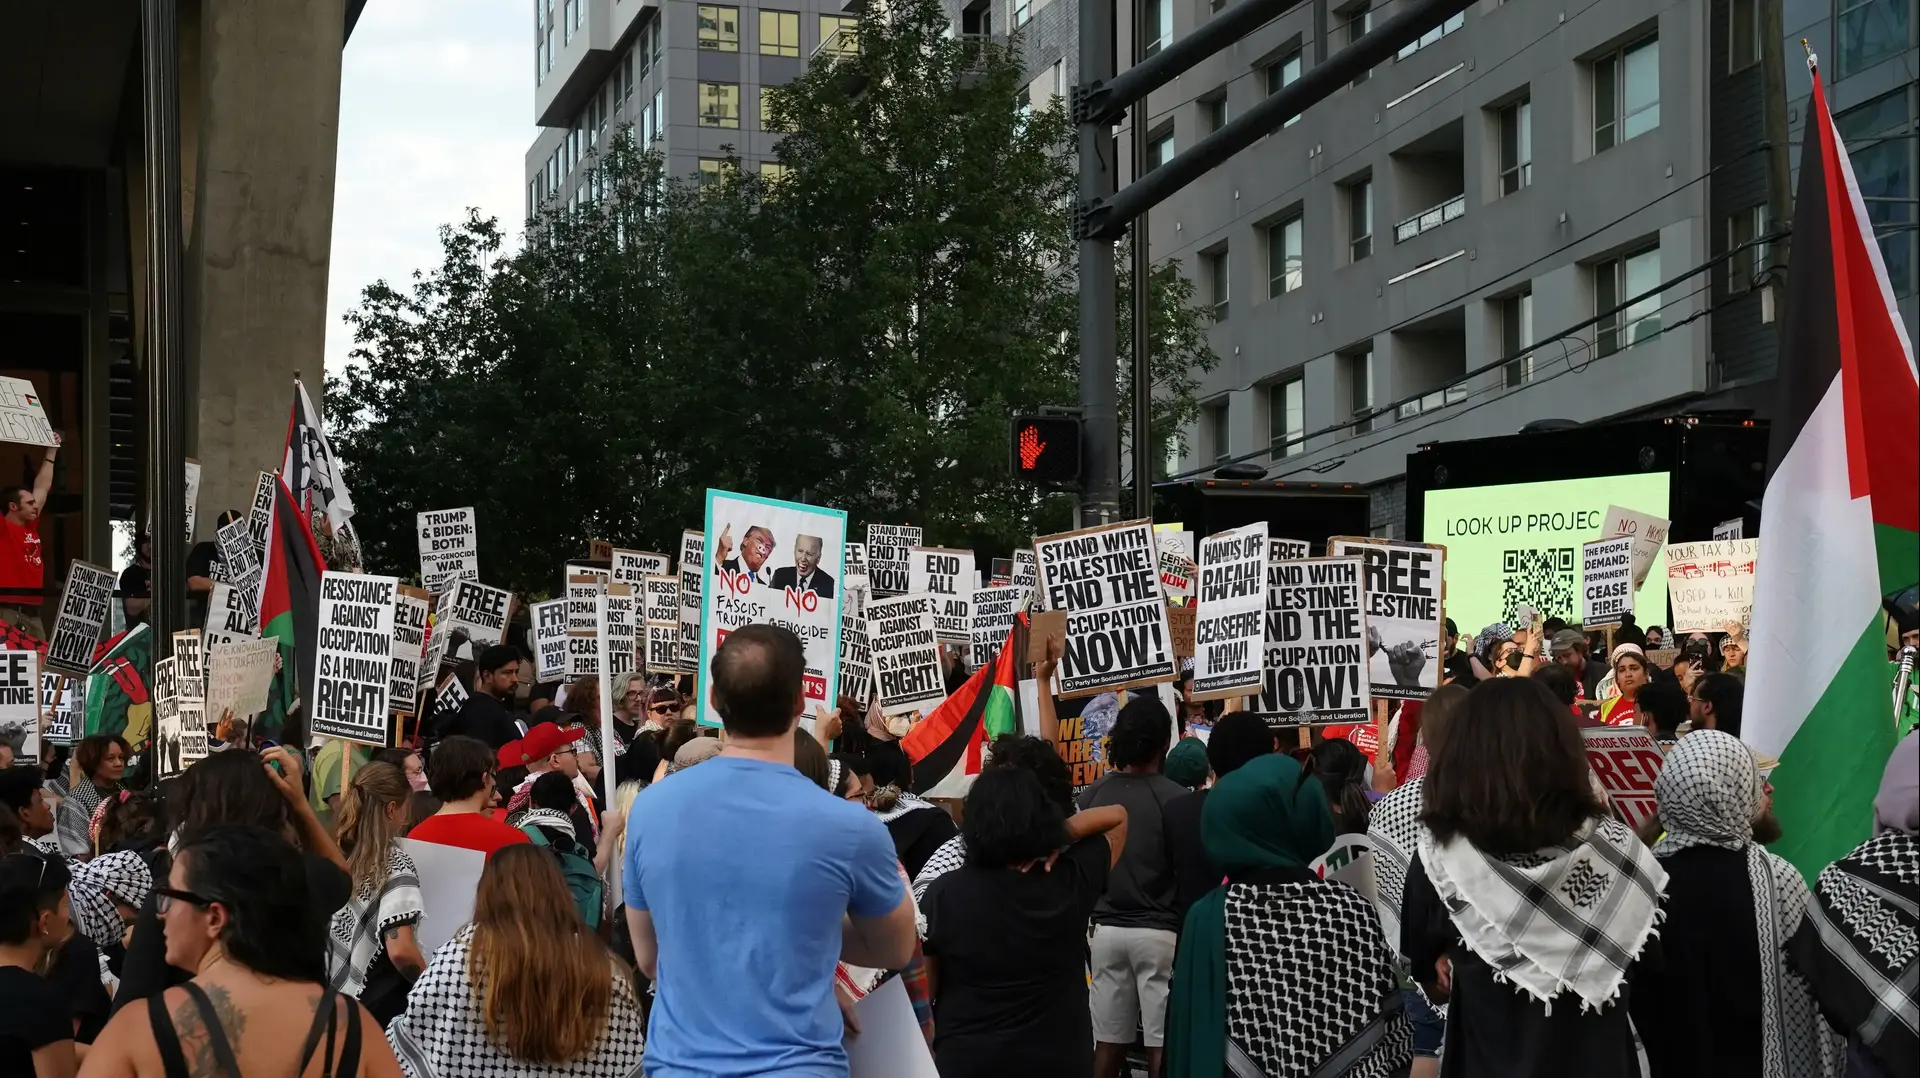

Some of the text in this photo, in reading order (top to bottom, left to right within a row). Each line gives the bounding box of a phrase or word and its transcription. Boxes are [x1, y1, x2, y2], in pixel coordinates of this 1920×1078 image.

[425, 512, 467, 526] TRUMP
[1447, 511, 1600, 537] LOOK UP PROJEC
[1617, 519, 1665, 542] NO ARMS
[422, 524, 473, 539] & BIDEN:
[869, 535, 920, 546] PALESTINE!
[870, 525, 921, 537] STAND WITH
[432, 537, 465, 551] BOTH
[869, 546, 894, 560] END
[1042, 536, 1099, 564] STAND
[1102, 527, 1148, 553] WITH
[1203, 533, 1264, 567] HANDS OFF
[1269, 541, 1306, 561] FREE
[1585, 542, 1629, 557] THE PEOPLE
[1667, 540, 1751, 560] YOUR TAX $ IS
[229, 554, 247, 579] END
[422, 550, 476, 562] PRO-GENOCIDE
[437, 560, 464, 572] WAR
[620, 555, 660, 571] TRUMP
[926, 555, 960, 575] END
[1046, 549, 1152, 585] PALESTINE!
[1584, 554, 1630, 570] DEMAND:
[72, 566, 114, 590] STAND WITH
[614, 568, 623, 579] &
[682, 571, 701, 594] FREE
[719, 568, 751, 600] NO
[869, 569, 910, 590] NOW
[928, 574, 957, 595] ALL
[1202, 559, 1262, 603] RAFAH!
[1308, 563, 1357, 585] WITH
[1584, 568, 1629, 582] PERMANENT
[69, 581, 111, 604] PALESTINE!
[322, 578, 392, 606] RESISTANCE
[456, 582, 508, 617] FREE
[571, 588, 583, 598] THE
[786, 585, 817, 617] NO
[1049, 579, 1103, 612] END
[1107, 570, 1157, 606] THE
[1586, 582, 1628, 600] CEASE
[1675, 589, 1706, 603] USED
[63, 595, 107, 624] END THE
[331, 604, 380, 629] AGAINST
[408, 605, 425, 630] ALL
[453, 605, 505, 630] PALESTINE
[717, 595, 766, 617] FASCIST
[867, 598, 929, 621] RESISTANCE
[944, 600, 968, 618] AID
[977, 601, 1013, 616] AGAINST
[1592, 599, 1624, 615] FIRE!
[58, 616, 100, 639] OCCUPATION
[651, 627, 669, 641] IS A
[769, 617, 829, 640] GENOCIDE
[879, 615, 921, 635] AGAINST
[1196, 609, 1261, 645] CEASEFIRE
[1308, 609, 1361, 640] THE
[50, 630, 97, 665] NOW!
[320, 627, 390, 656] OCCUPATION
[871, 630, 934, 653] OCCUPATION
[982, 631, 990, 643] A
[176, 639, 200, 677] FREE
[850, 644, 872, 665] THE
[877, 648, 937, 671] IS A HUMAN
[1064, 623, 1165, 678] NOW!
[1207, 641, 1249, 675] NOW!
[320, 654, 387, 684] IS A HUMAN
[880, 663, 940, 698] RIGHT!
[1075, 679, 1091, 687] Party
[1101, 673, 1128, 683] Socialism
[1142, 666, 1171, 676] Liberation
[177, 678, 203, 698] PALESTINE
[1201, 681, 1210, 689] Party
[1216, 678, 1233, 687] Socialism
[1234, 677, 1242, 685] and
[1241, 674, 1260, 684] Liberation
[1259, 665, 1362, 713] NOW!
[317, 678, 385, 727] RIGHT!
[180, 710, 206, 732] POLITICAL
[1059, 717, 1086, 741] WE
[1277, 715, 1287, 723] for
[1333, 712, 1366, 720] Liberation
[320, 723, 330, 732] Party
[336, 726, 355, 736] Socialism
[355, 729, 363, 737] and
[363, 729, 384, 740] Liberation
[1617, 736, 1653, 748] IS OUR
[1059, 739, 1093, 763] ARE
[1587, 750, 1664, 790] RED
